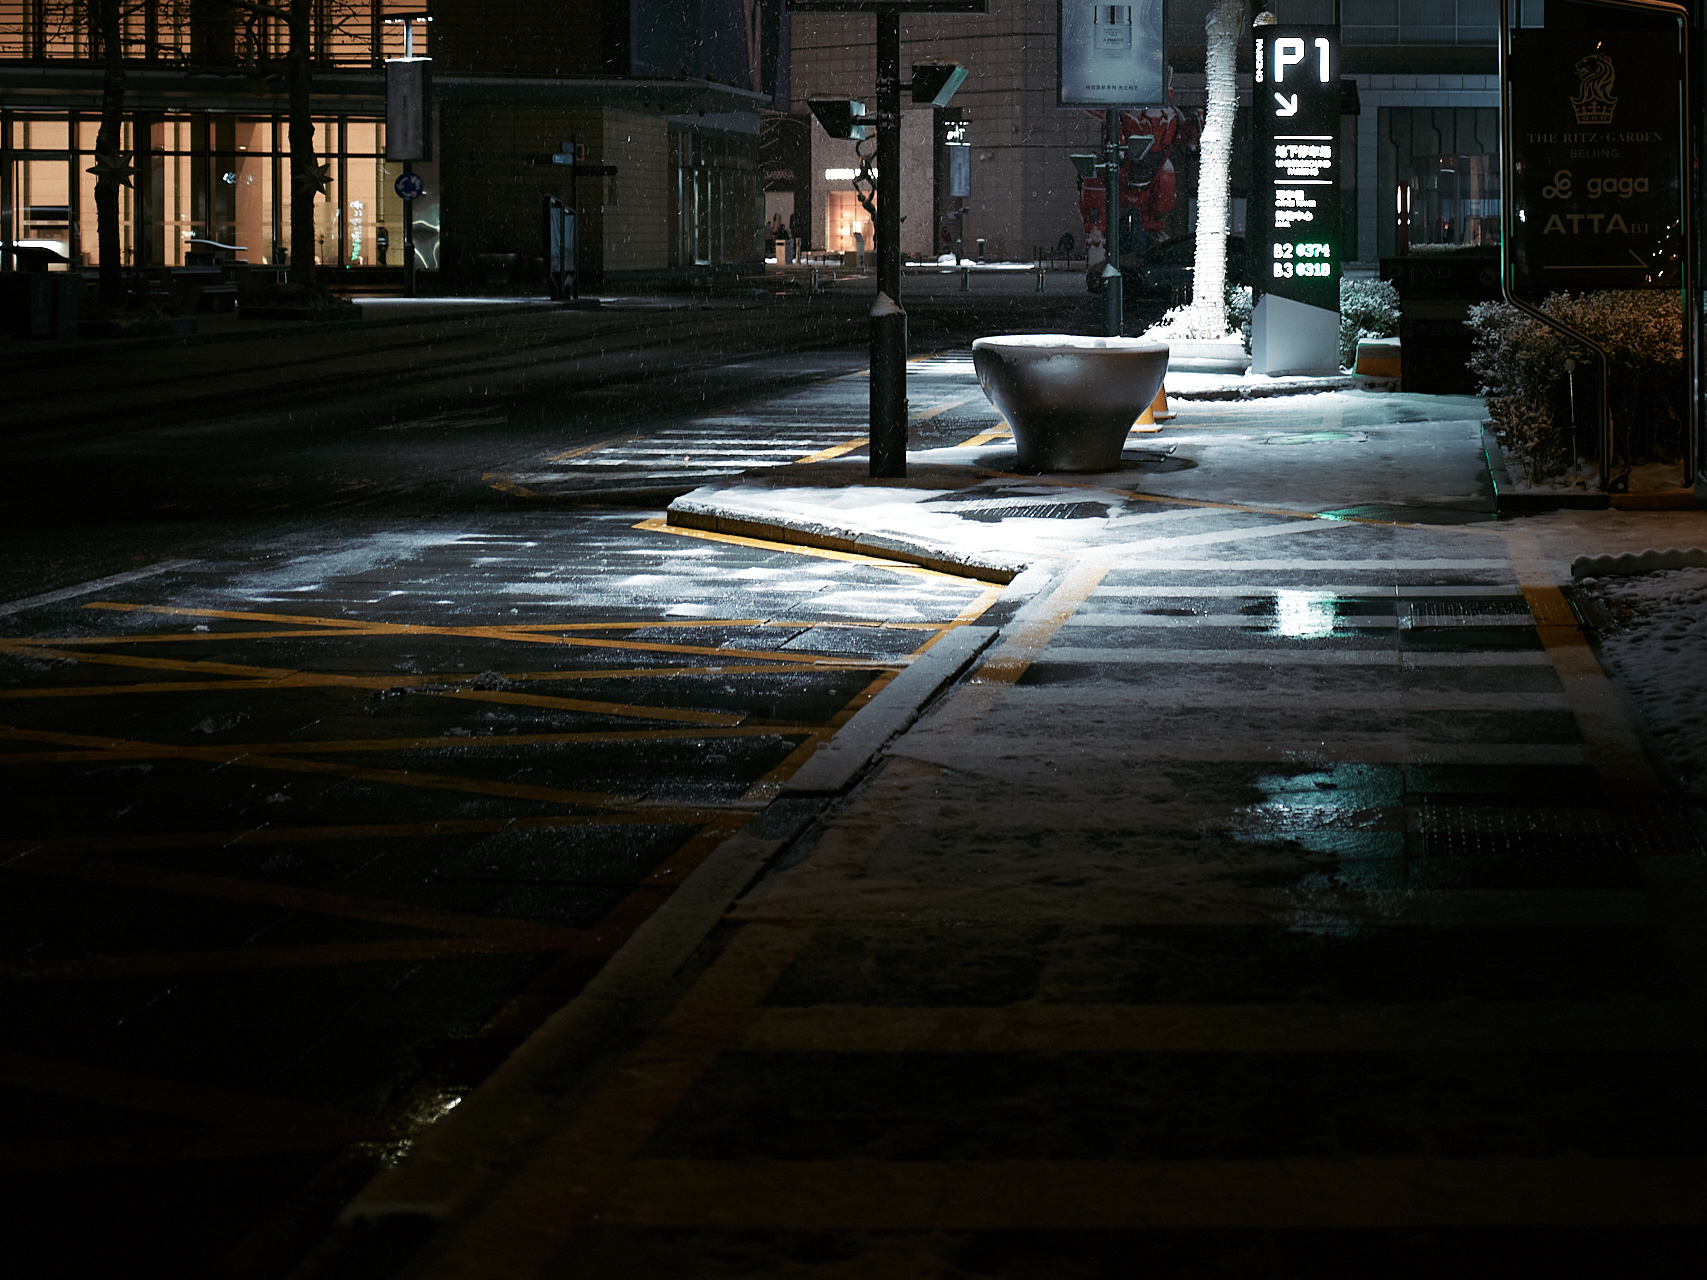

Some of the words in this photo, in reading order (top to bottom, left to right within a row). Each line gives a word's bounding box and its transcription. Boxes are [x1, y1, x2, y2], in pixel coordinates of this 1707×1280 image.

[1274, 37, 1330, 83] P1
[1526, 132, 1558, 144] THE
[1569, 148, 1620, 159] BEIJING
[1586, 177, 1649, 199] gaga
[1543, 213, 1630, 235] ATTA
[1273, 243, 1294, 258] B2
[1295, 243, 1331, 257] 0374
[1273, 262, 1294, 278] B3
